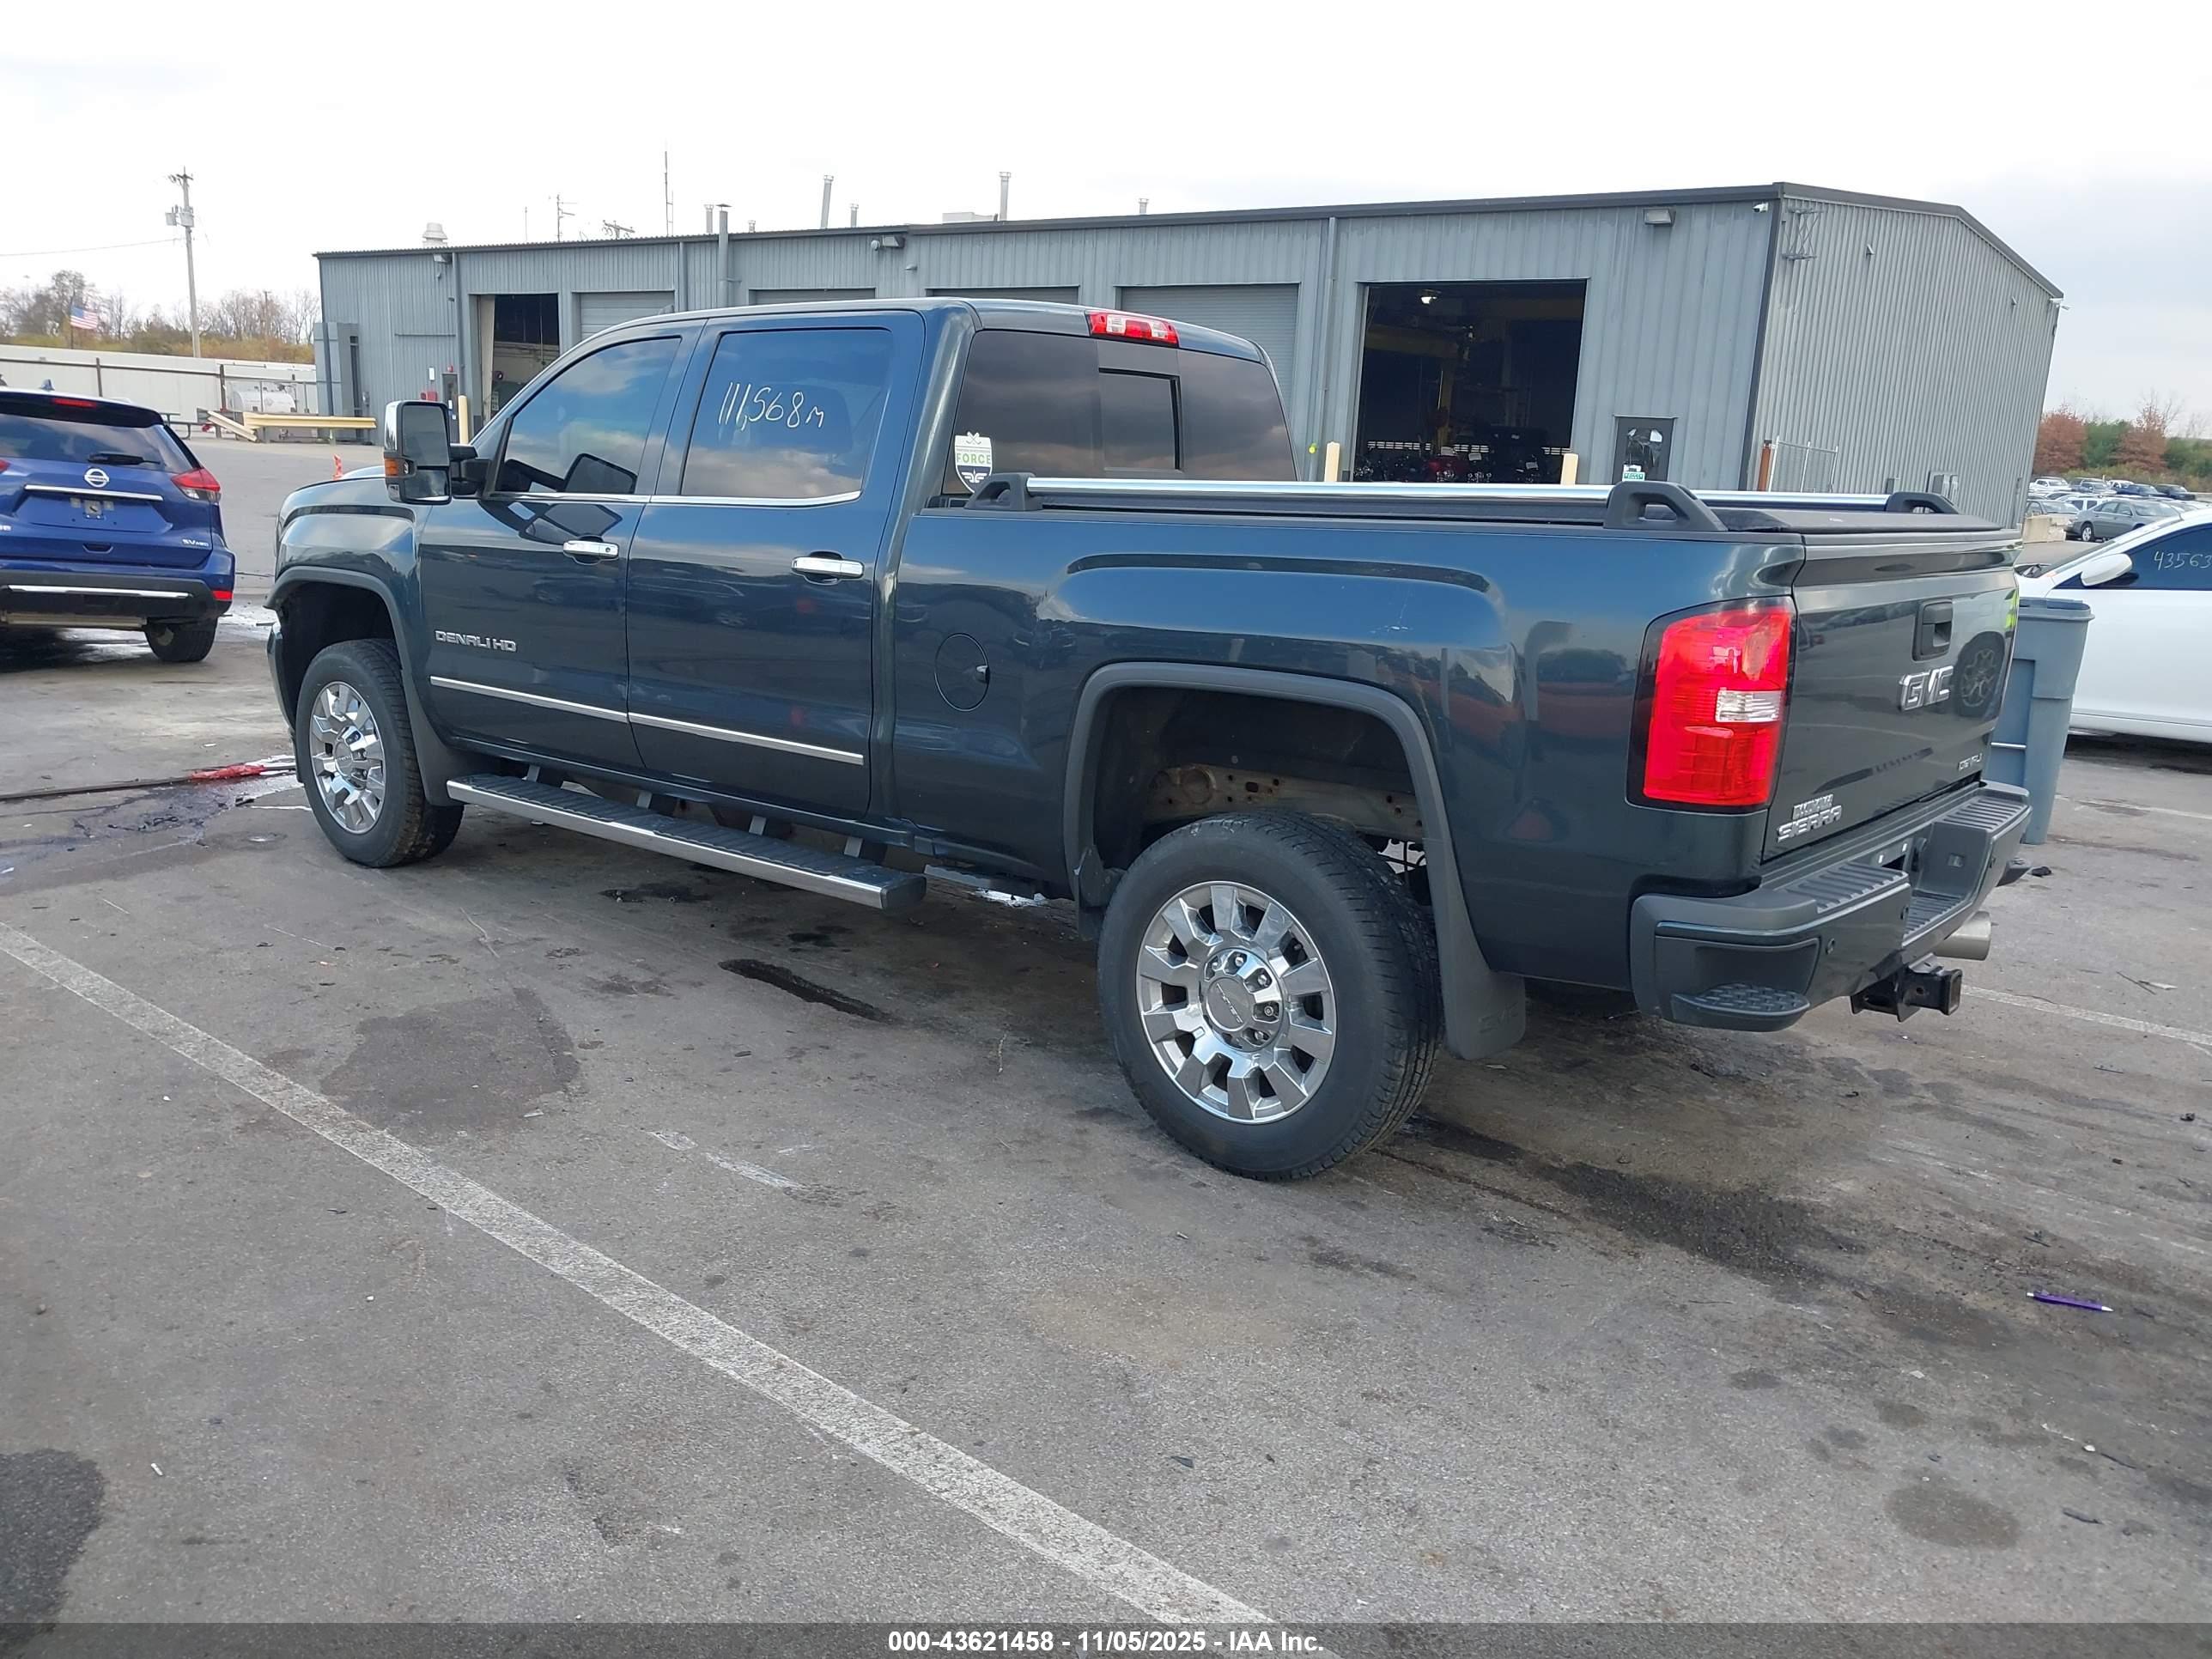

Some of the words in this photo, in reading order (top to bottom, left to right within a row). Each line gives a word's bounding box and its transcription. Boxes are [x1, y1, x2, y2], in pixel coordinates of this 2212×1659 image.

[956, 453, 991, 465] FORCE
[434, 630, 490, 649] DENALI
[492, 638, 516, 652] HD
[1899, 665, 1954, 710] GMC
[1777, 805, 1842, 842] SIERRA
